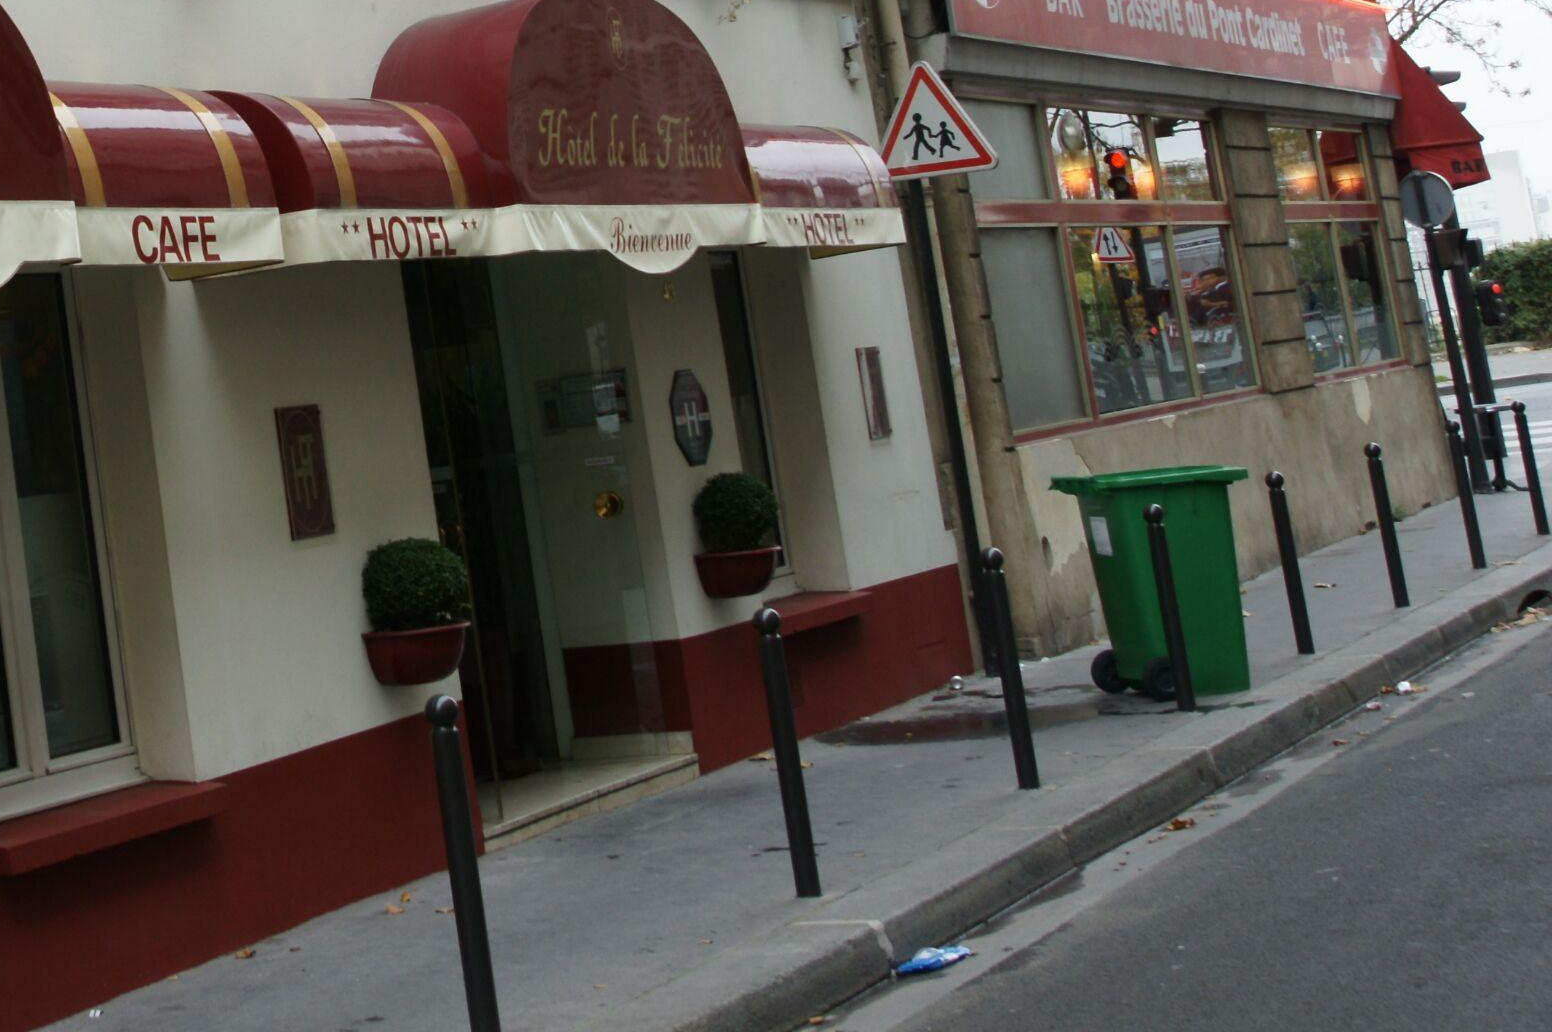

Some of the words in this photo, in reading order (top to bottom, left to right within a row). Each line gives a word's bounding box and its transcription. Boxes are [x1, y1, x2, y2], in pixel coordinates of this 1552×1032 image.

[1245, 7, 1306, 56] Cardinet
[1316, 21, 1351, 64] CAFE
[607, 113, 626, 168] de
[631, 114, 649, 168] la
[131, 215, 221, 264] CAFE
[366, 215, 457, 259] HOTEL
[610, 216, 693, 255] Bienvenue
[802, 213, 854, 245] HOTEL
